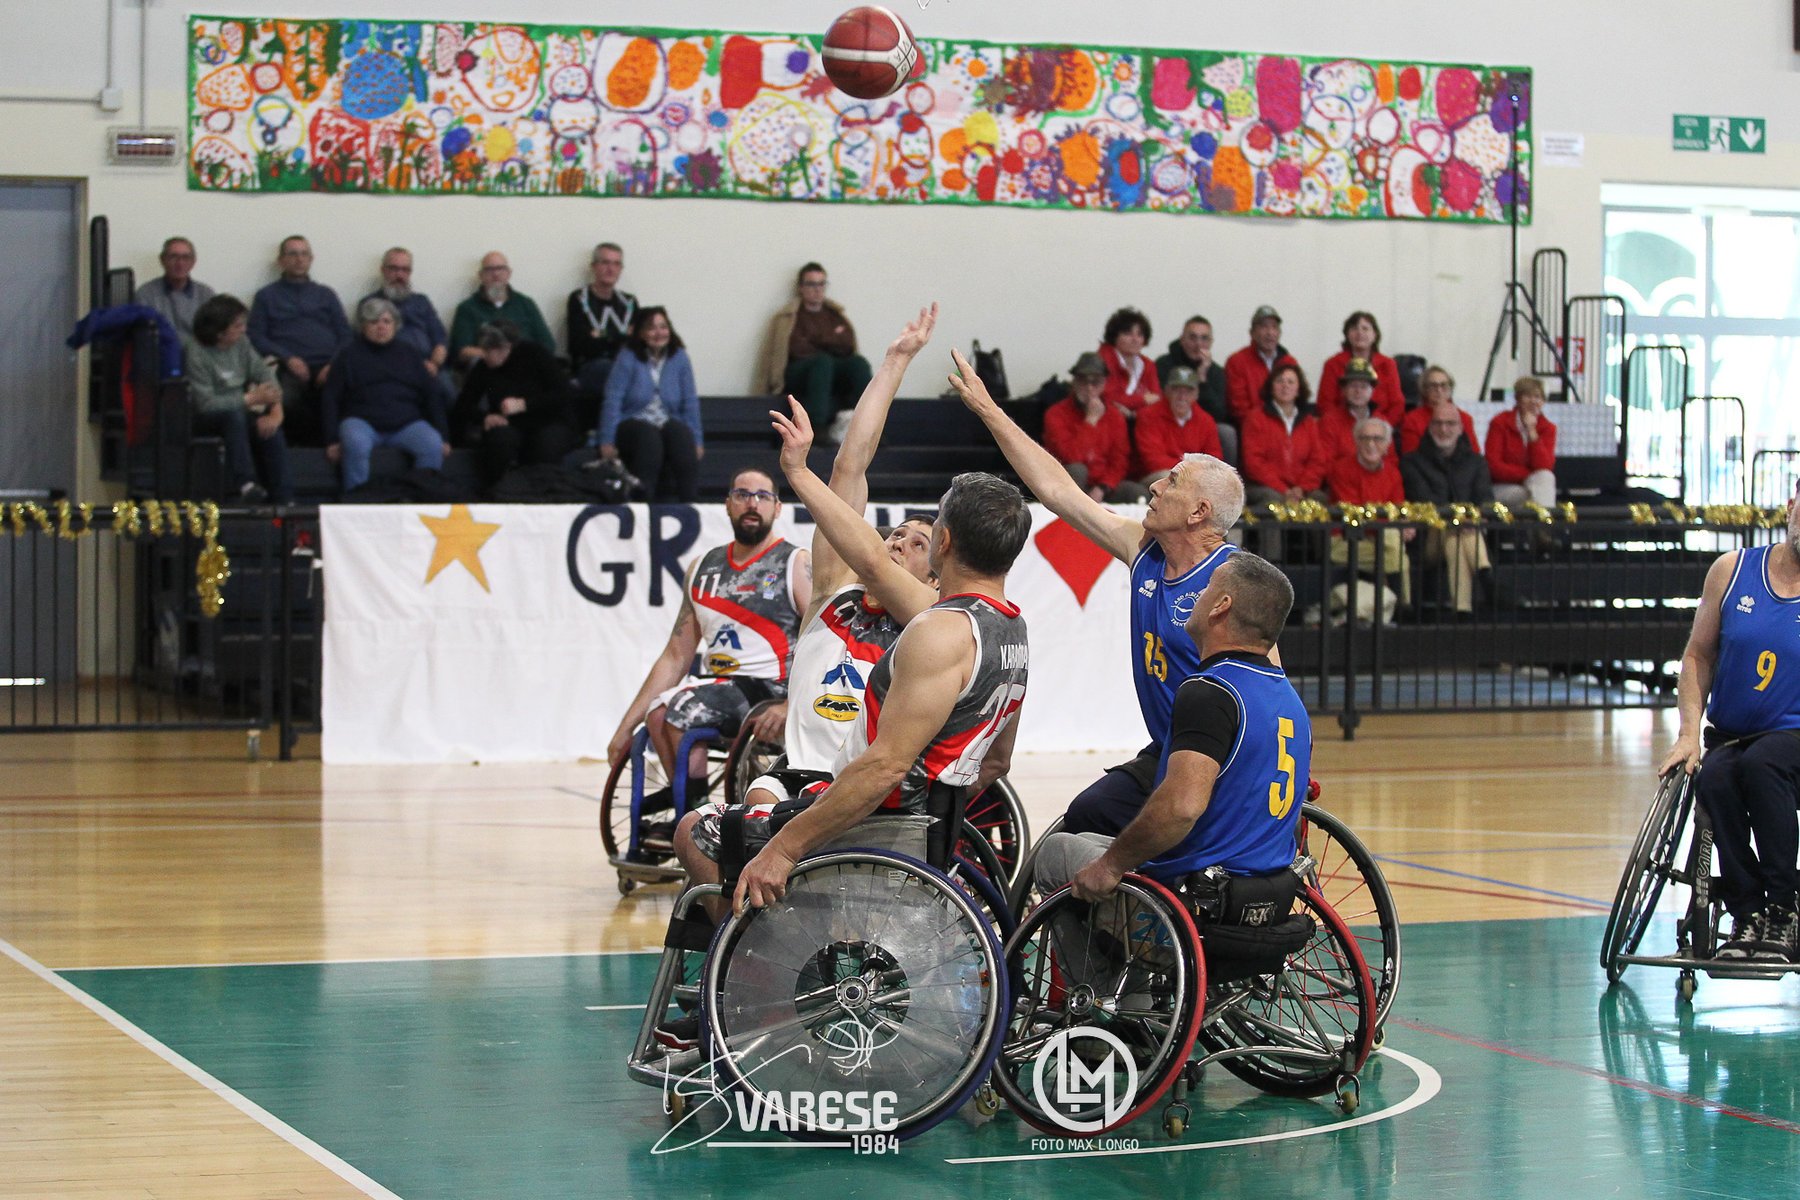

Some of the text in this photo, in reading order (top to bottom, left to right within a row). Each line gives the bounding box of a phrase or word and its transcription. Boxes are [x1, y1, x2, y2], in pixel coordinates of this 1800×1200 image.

[698, 573, 721, 599] 11
[1753, 650, 1777, 692] 9
[1268, 716, 1296, 820] 5
